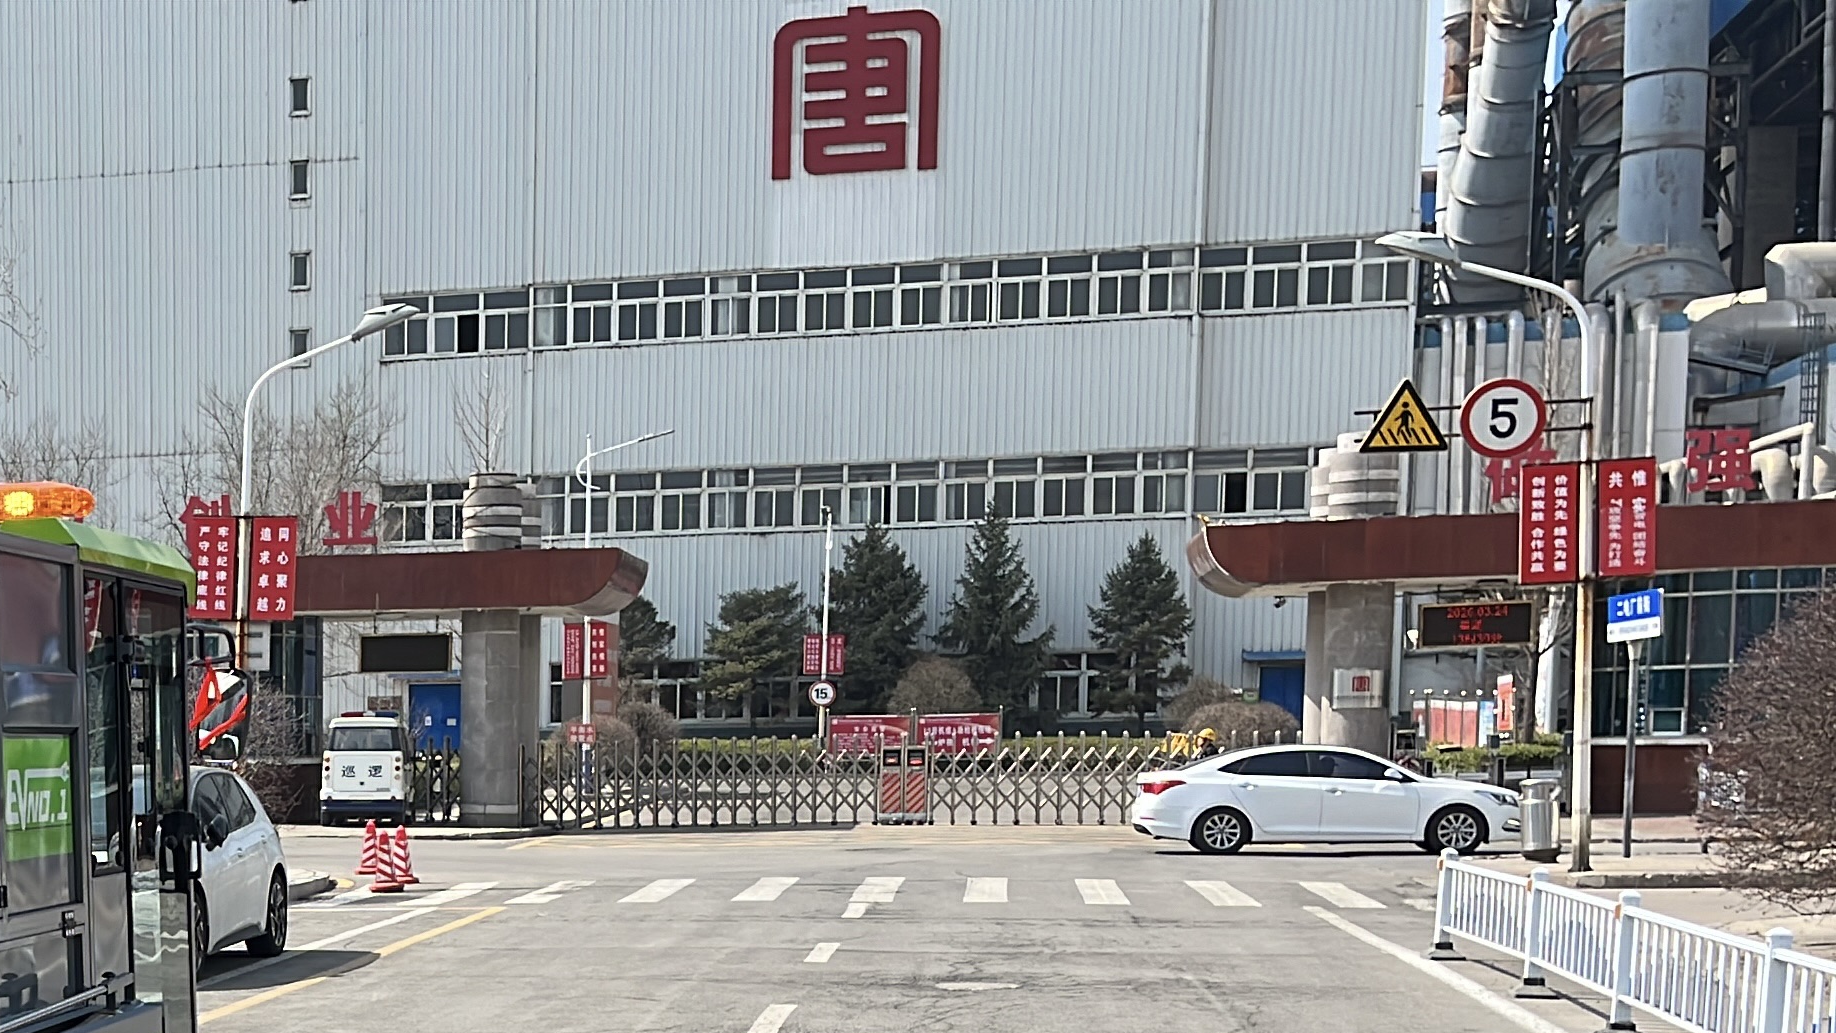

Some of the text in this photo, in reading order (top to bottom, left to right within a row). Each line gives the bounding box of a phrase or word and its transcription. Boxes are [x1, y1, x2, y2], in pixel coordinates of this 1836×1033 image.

[1489, 398, 1518, 438] 5
[256, 527, 272, 612] 追求卓越
[275, 527, 289, 612] 同心聚力
[814, 688, 828, 699] 15
[341, 764, 383, 778] 巡逻
